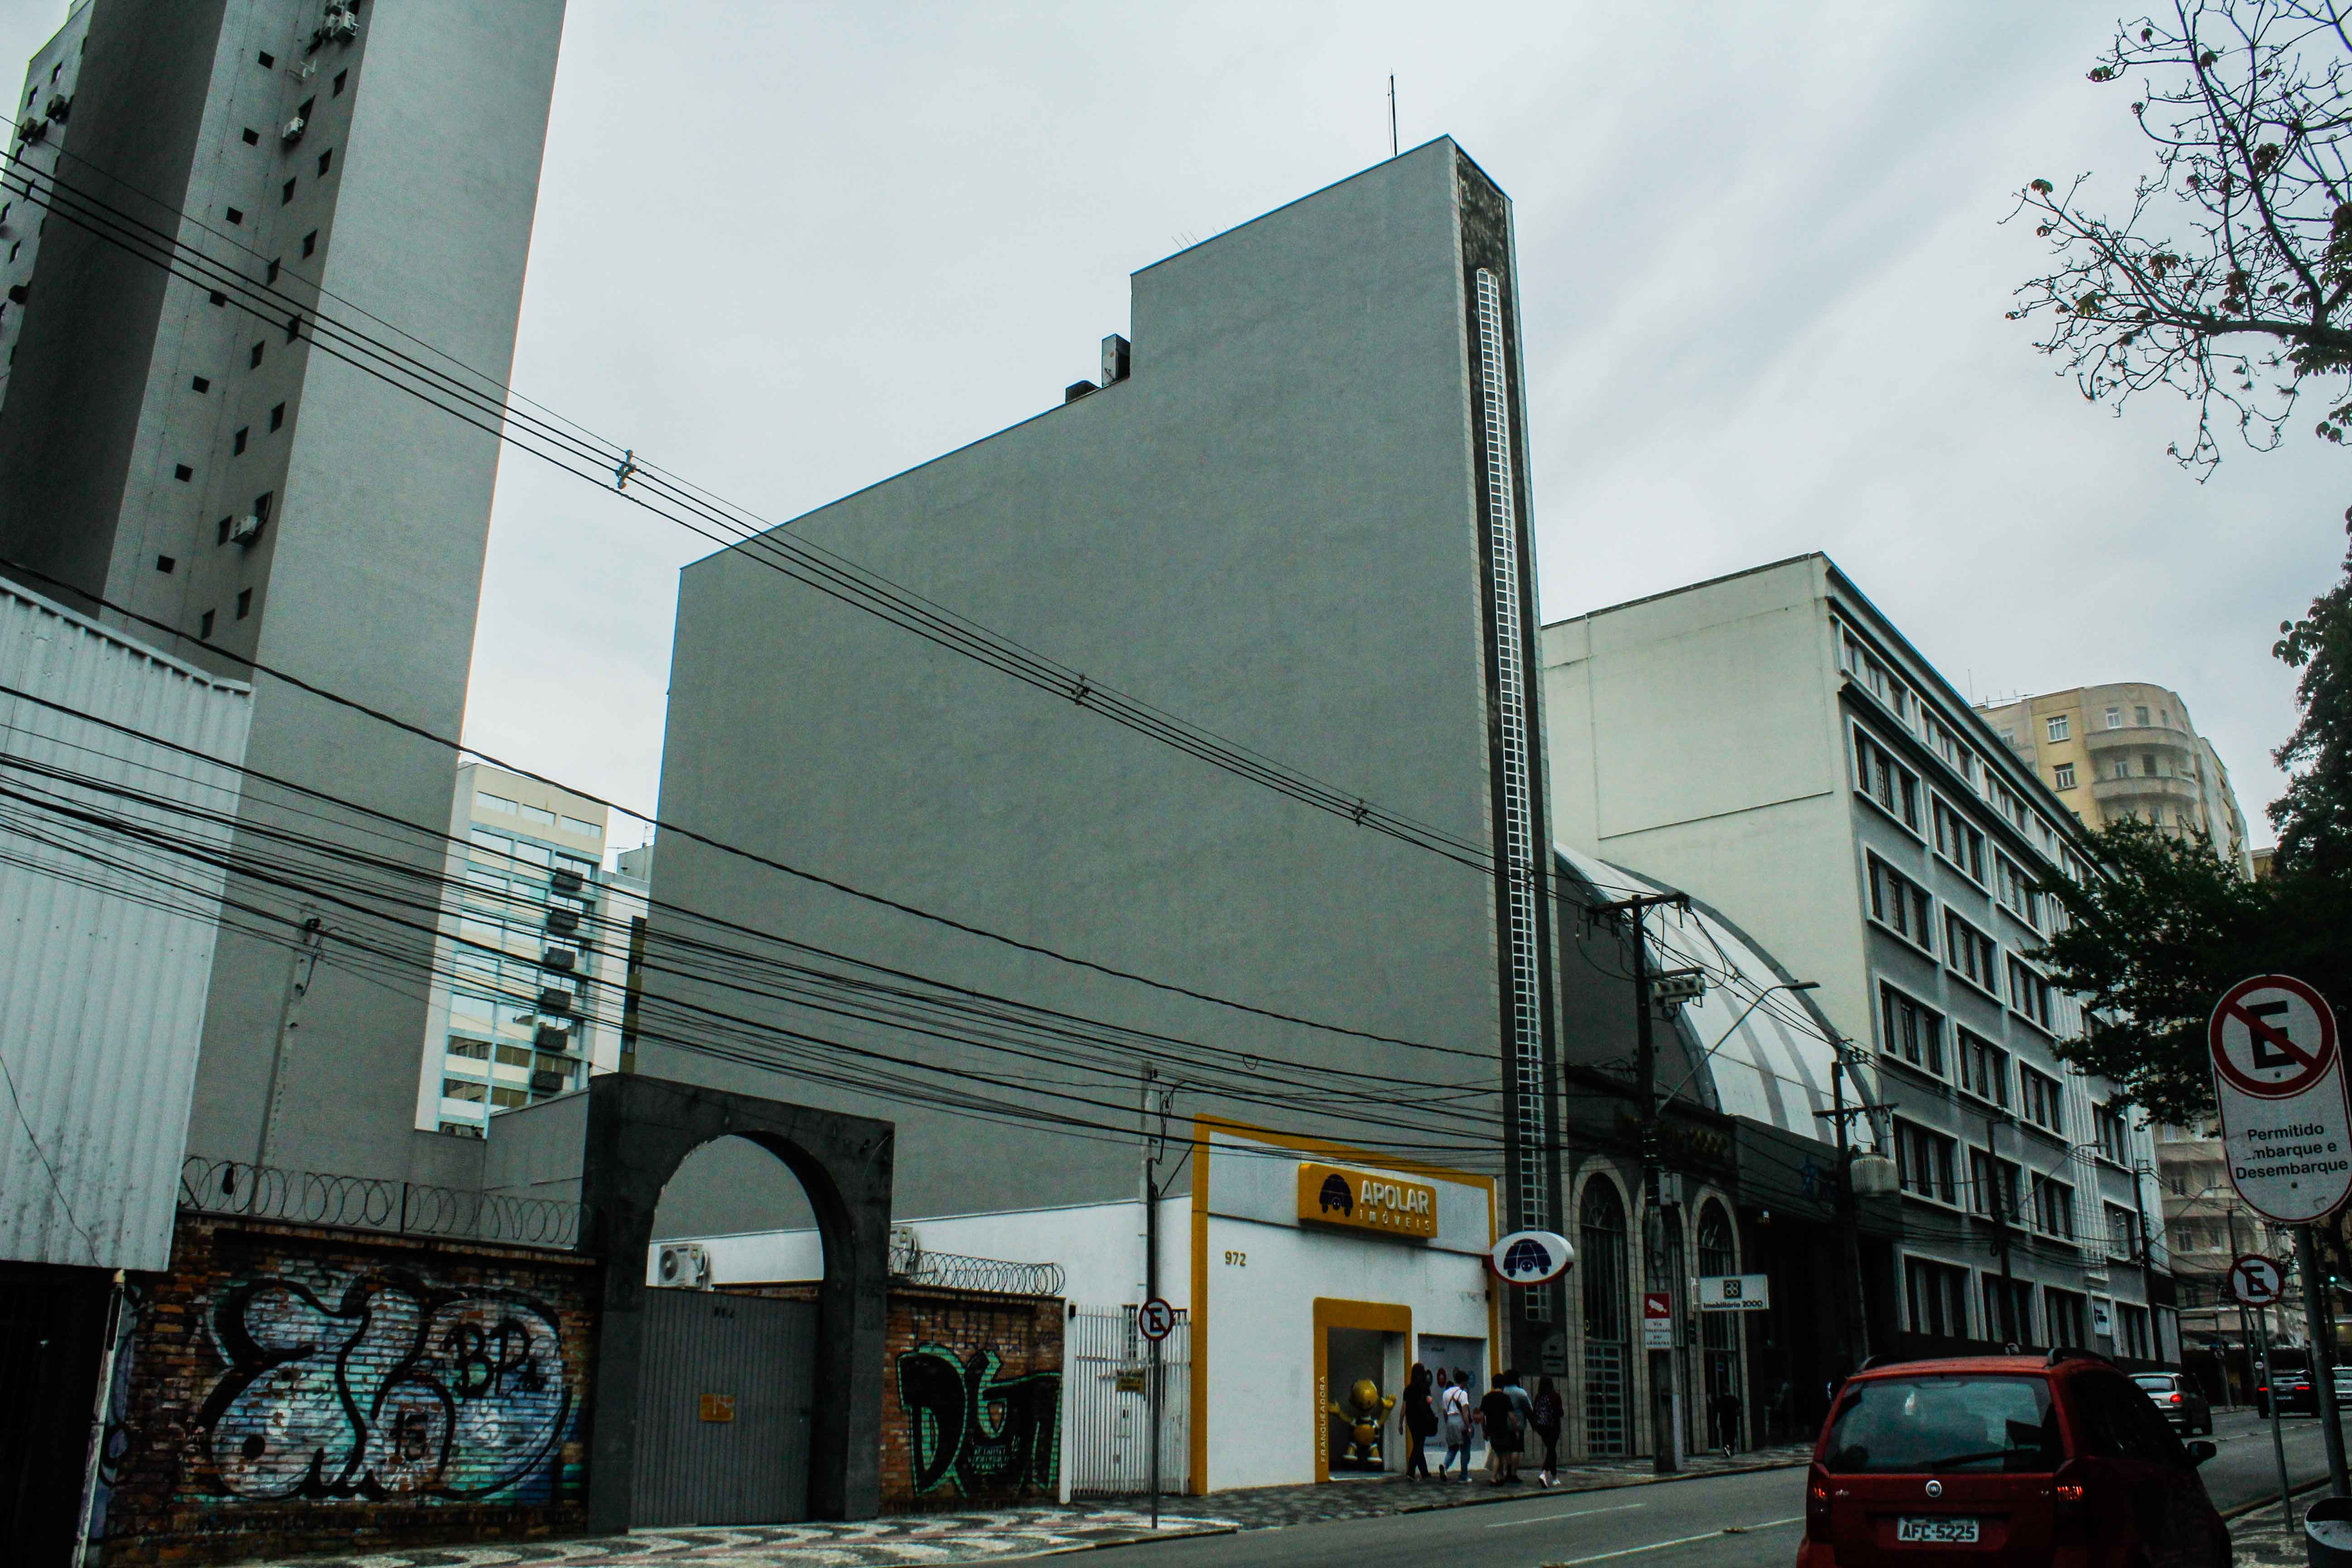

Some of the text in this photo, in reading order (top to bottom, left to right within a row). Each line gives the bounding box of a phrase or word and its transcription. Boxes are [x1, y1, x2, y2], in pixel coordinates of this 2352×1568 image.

[2247, 1123, 2324, 1141] Permitido
[2244, 1143, 2337, 1160] mbarque e
[2235, 1160, 2348, 1180] Desembarque
[1360, 1180, 1429, 1215] APOLAR
[1359, 1208, 1430, 1231] IMÓVEIS
[1225, 1251, 1246, 1267] 972
[1742, 1299, 1764, 1308] 2000
[1902, 1525, 1975, 1540] AFC-5225
